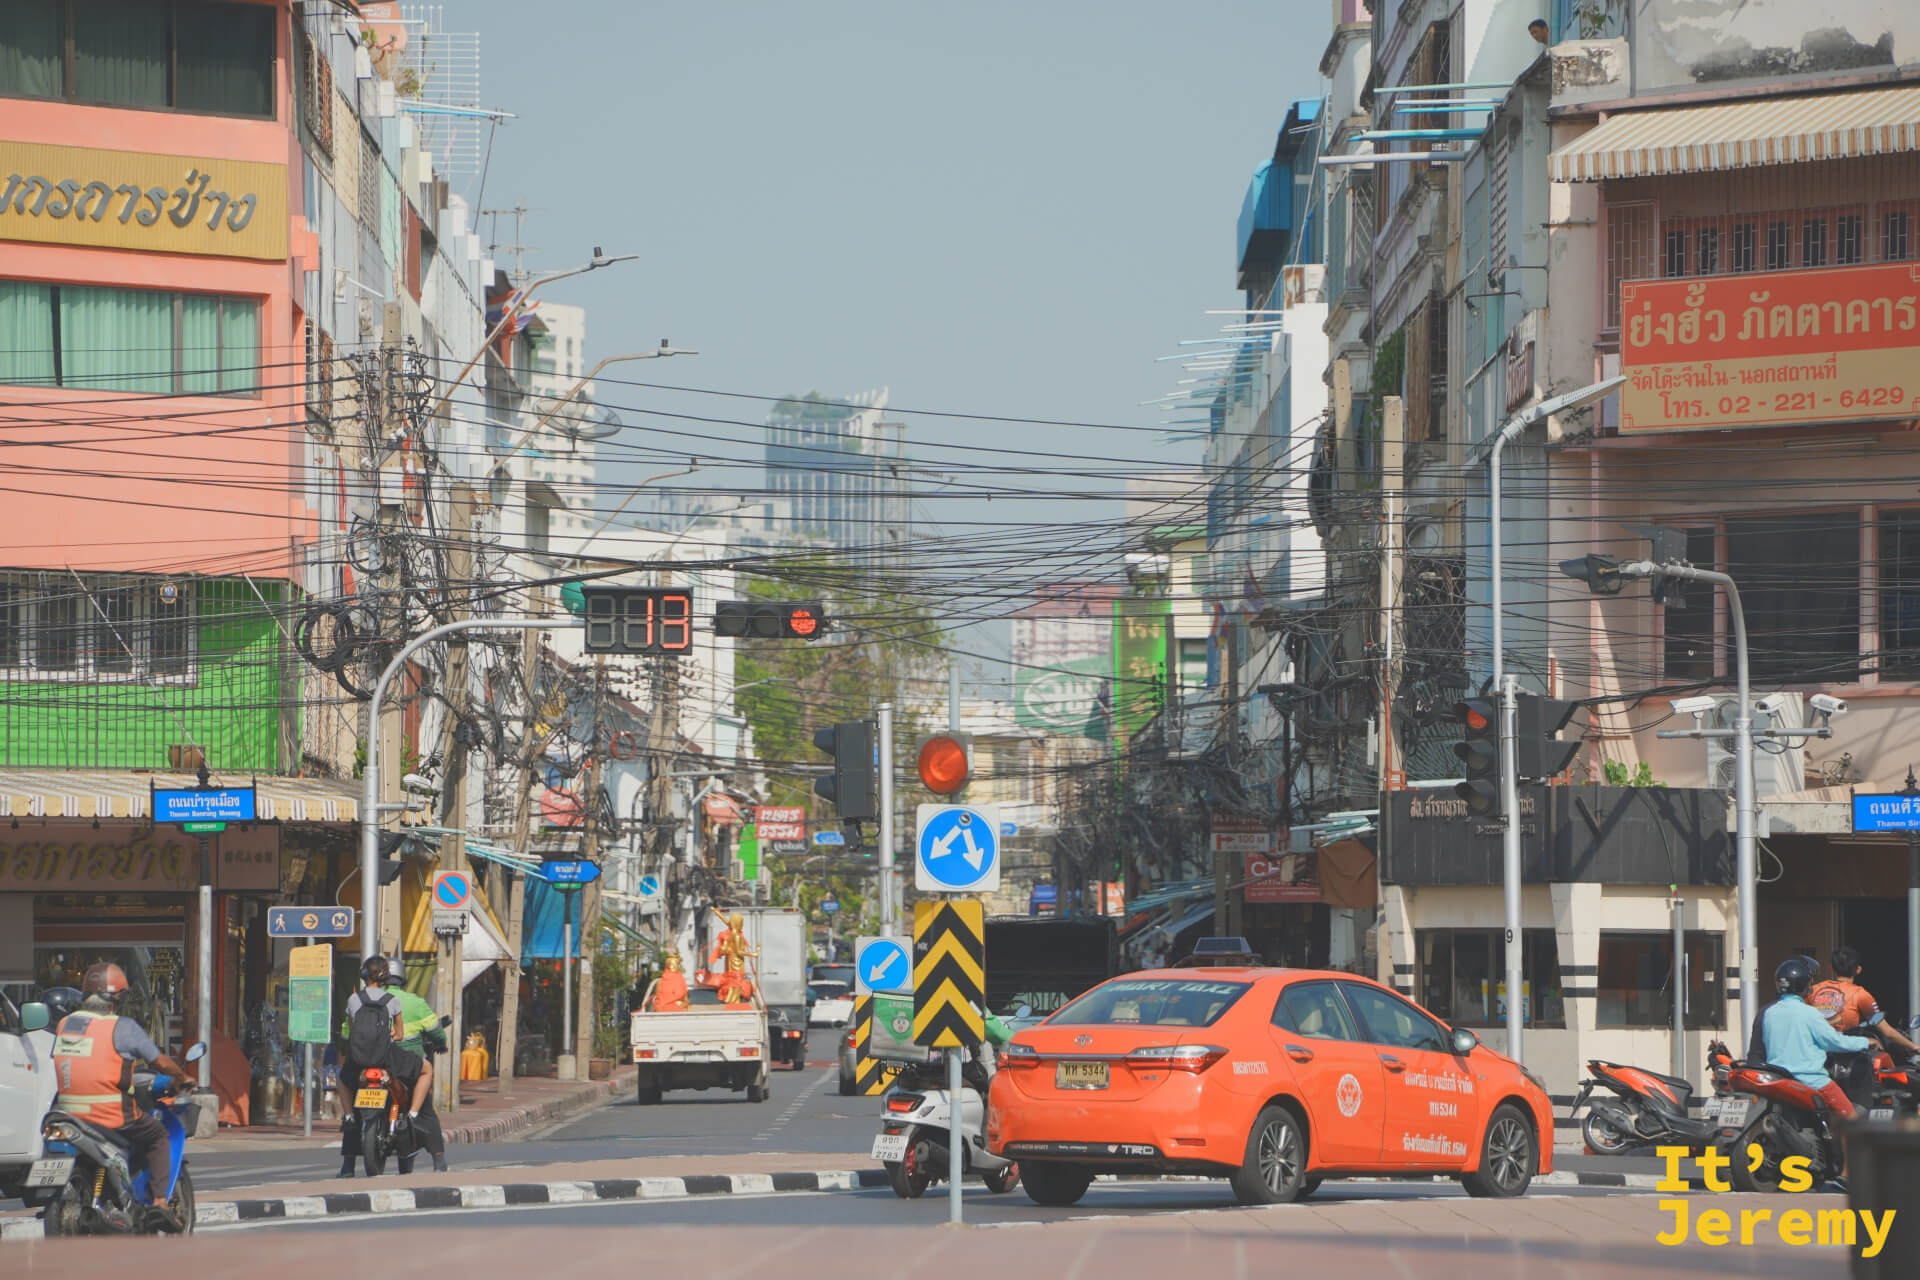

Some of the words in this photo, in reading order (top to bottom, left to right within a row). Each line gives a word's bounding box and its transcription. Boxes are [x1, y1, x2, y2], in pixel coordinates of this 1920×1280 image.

[1630, 283, 1726, 348] ย่งฮั้ว
[1738, 291, 1917, 341] ภัตตาคาร
[1659, 391, 1710, 419] โทร.
[1718, 396, 1751, 415] 02
[1775, 391, 1816, 412] 221
[1839, 386, 1905, 408] 6429
[1876, 819, 1906, 827] Thanon
[1082, 1064, 1105, 1077] 5344
[1121, 1145, 1154, 1155] TRD
